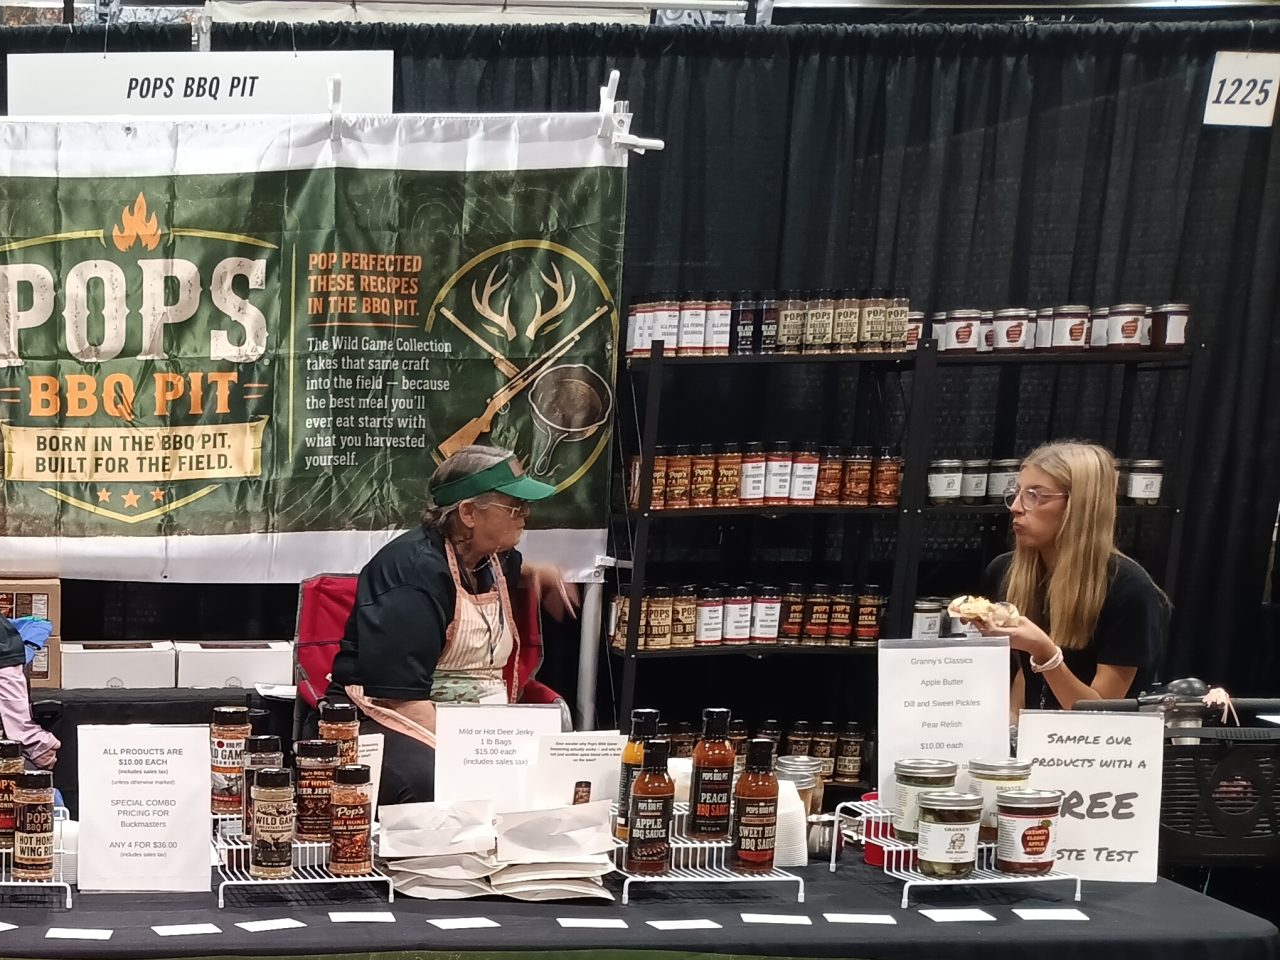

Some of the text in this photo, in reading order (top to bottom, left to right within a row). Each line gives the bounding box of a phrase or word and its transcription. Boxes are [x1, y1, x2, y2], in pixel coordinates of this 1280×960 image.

[127, 76, 258, 100] POPS BBQ PIT
[1212, 78, 1273, 105] 1225
[309, 252, 422, 272] POP PERFECTED
[308, 276, 418, 294] THESE RECIPES
[308, 297, 419, 316] IN THE BBQ PIT.
[28, 372, 238, 421] BBQ PIT
[36, 432, 231, 451] BORN IN THE BBQ PIT,
[36, 454, 233, 473] BUILT FOR THE FIELD.
[911, 658, 942, 666] Granny's
[1047, 732, 1132, 746] SAMPLE OUR
[1031, 757, 1146, 769] PRODUCTS WITH A
[701, 793, 727, 803] PEACH
[1055, 790, 1139, 819] REE
[27, 813, 52, 823] POP'S
[336, 806, 364, 817] Pop's
[256, 816, 277, 825] WILD
[636, 819, 662, 828] APPLE
[633, 829, 666, 839] BBQ SAUCE
[739, 827, 762, 837] SWEET
[1056, 848, 1138, 862] STE TEST
